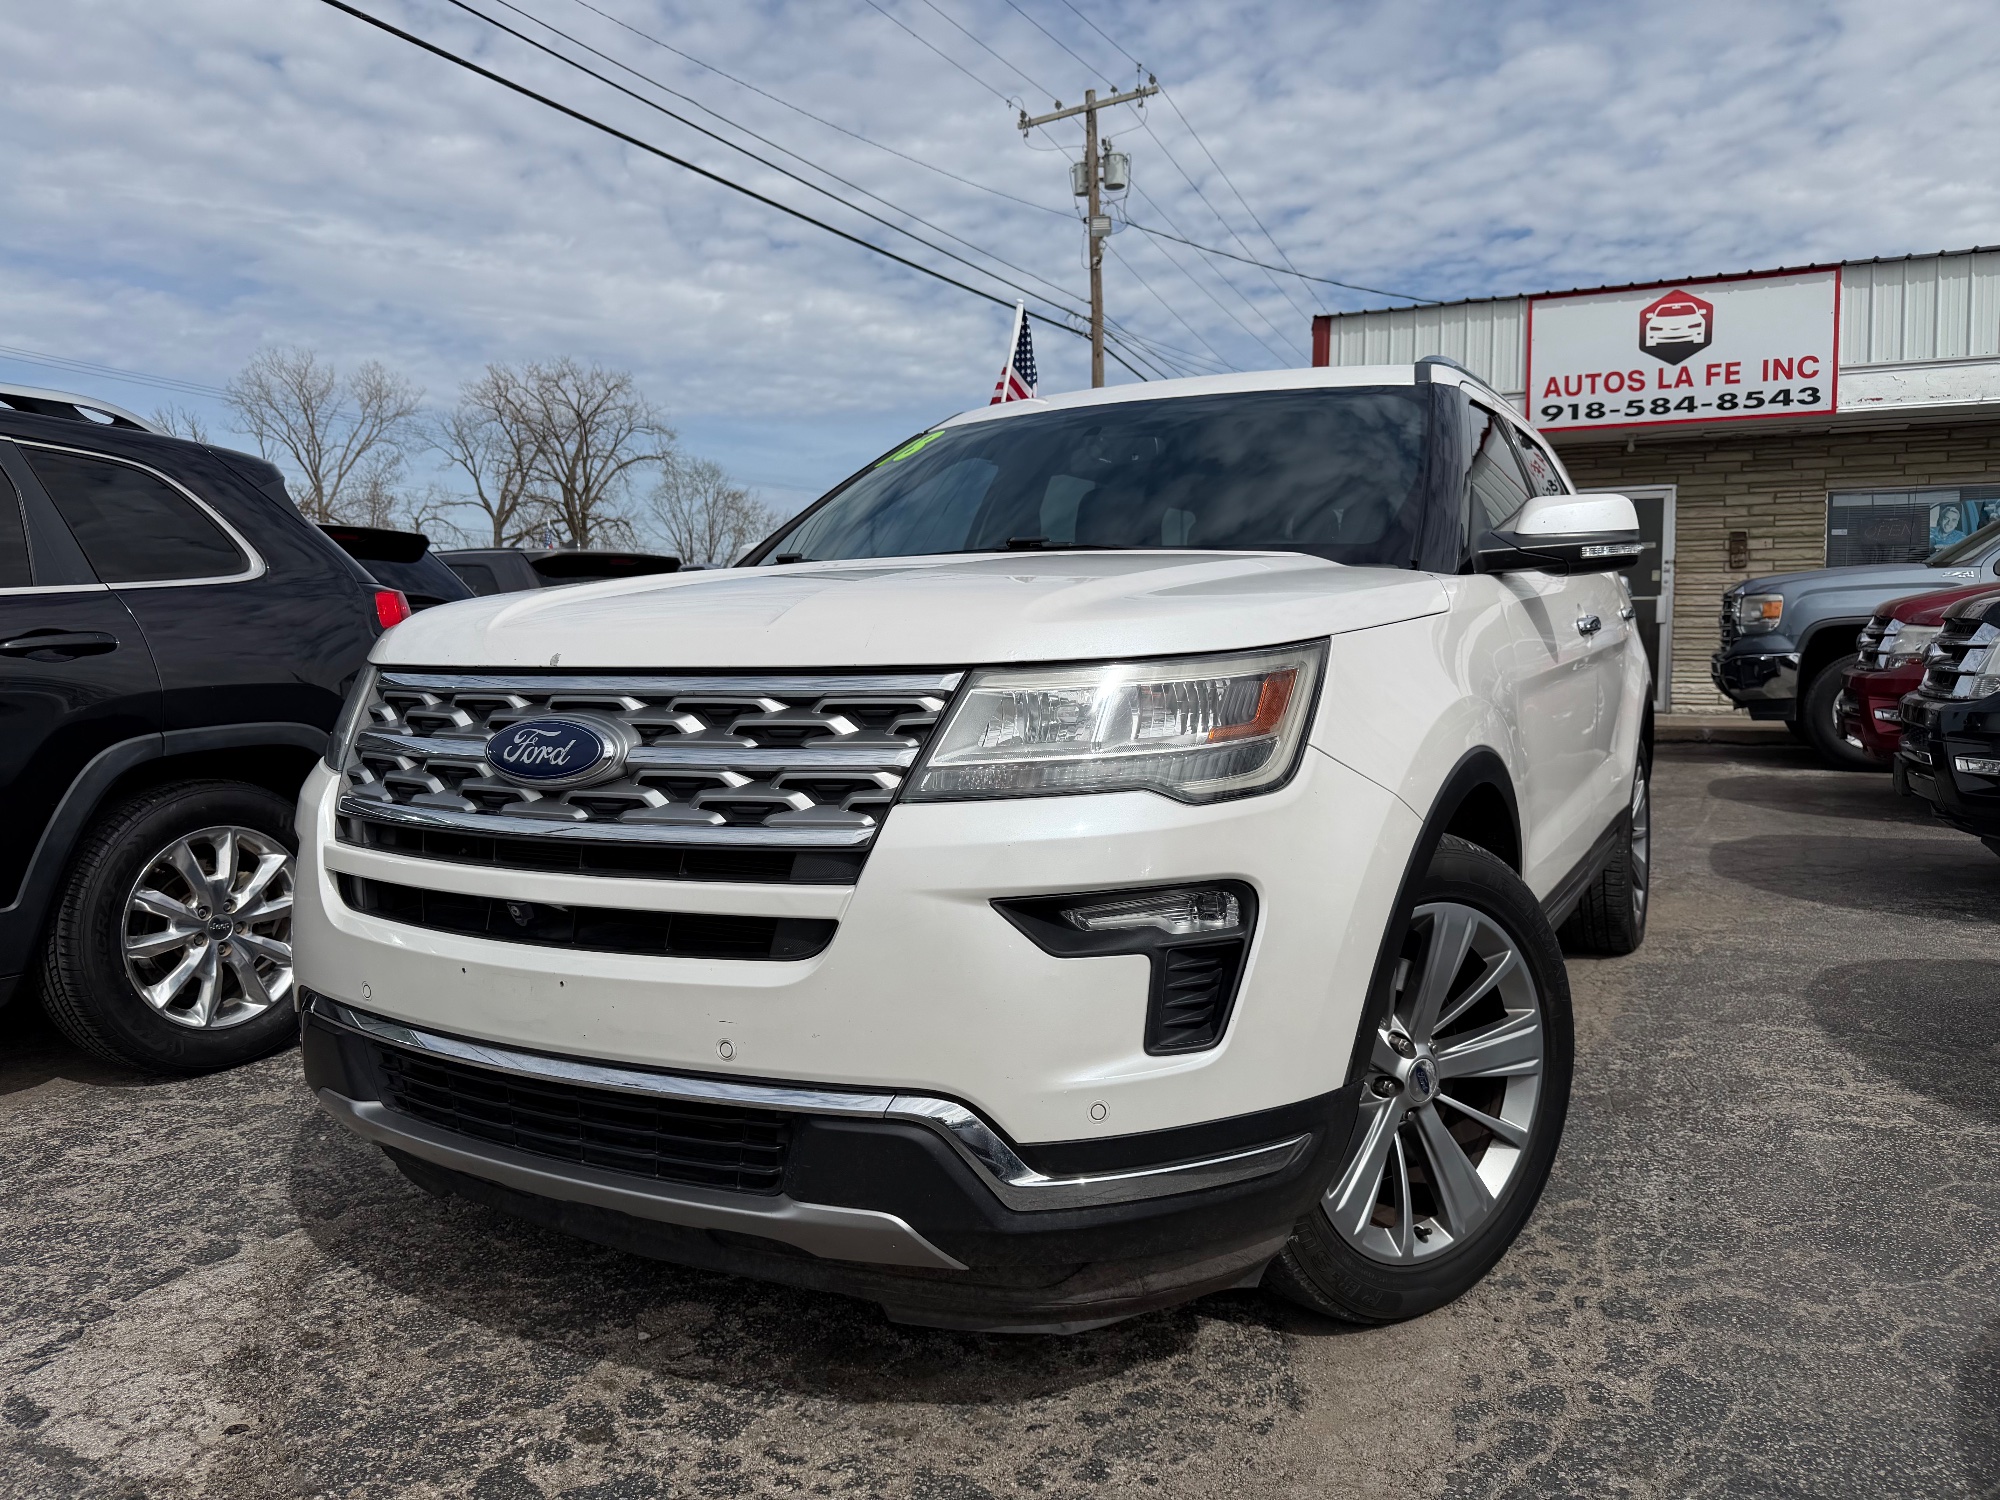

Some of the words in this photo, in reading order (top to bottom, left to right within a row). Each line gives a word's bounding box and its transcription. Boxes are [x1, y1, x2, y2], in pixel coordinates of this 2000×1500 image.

[1542, 369, 1646, 399] AUTOS
[1657, 365, 1695, 390] LA
[1705, 361, 1742, 386] FE
[1761, 355, 1820, 382] INC
[1541, 386, 1822, 422] 918-584-8543
[502, 728, 577, 766] Ford
[1295, 1222, 1384, 1307] RB-SU
